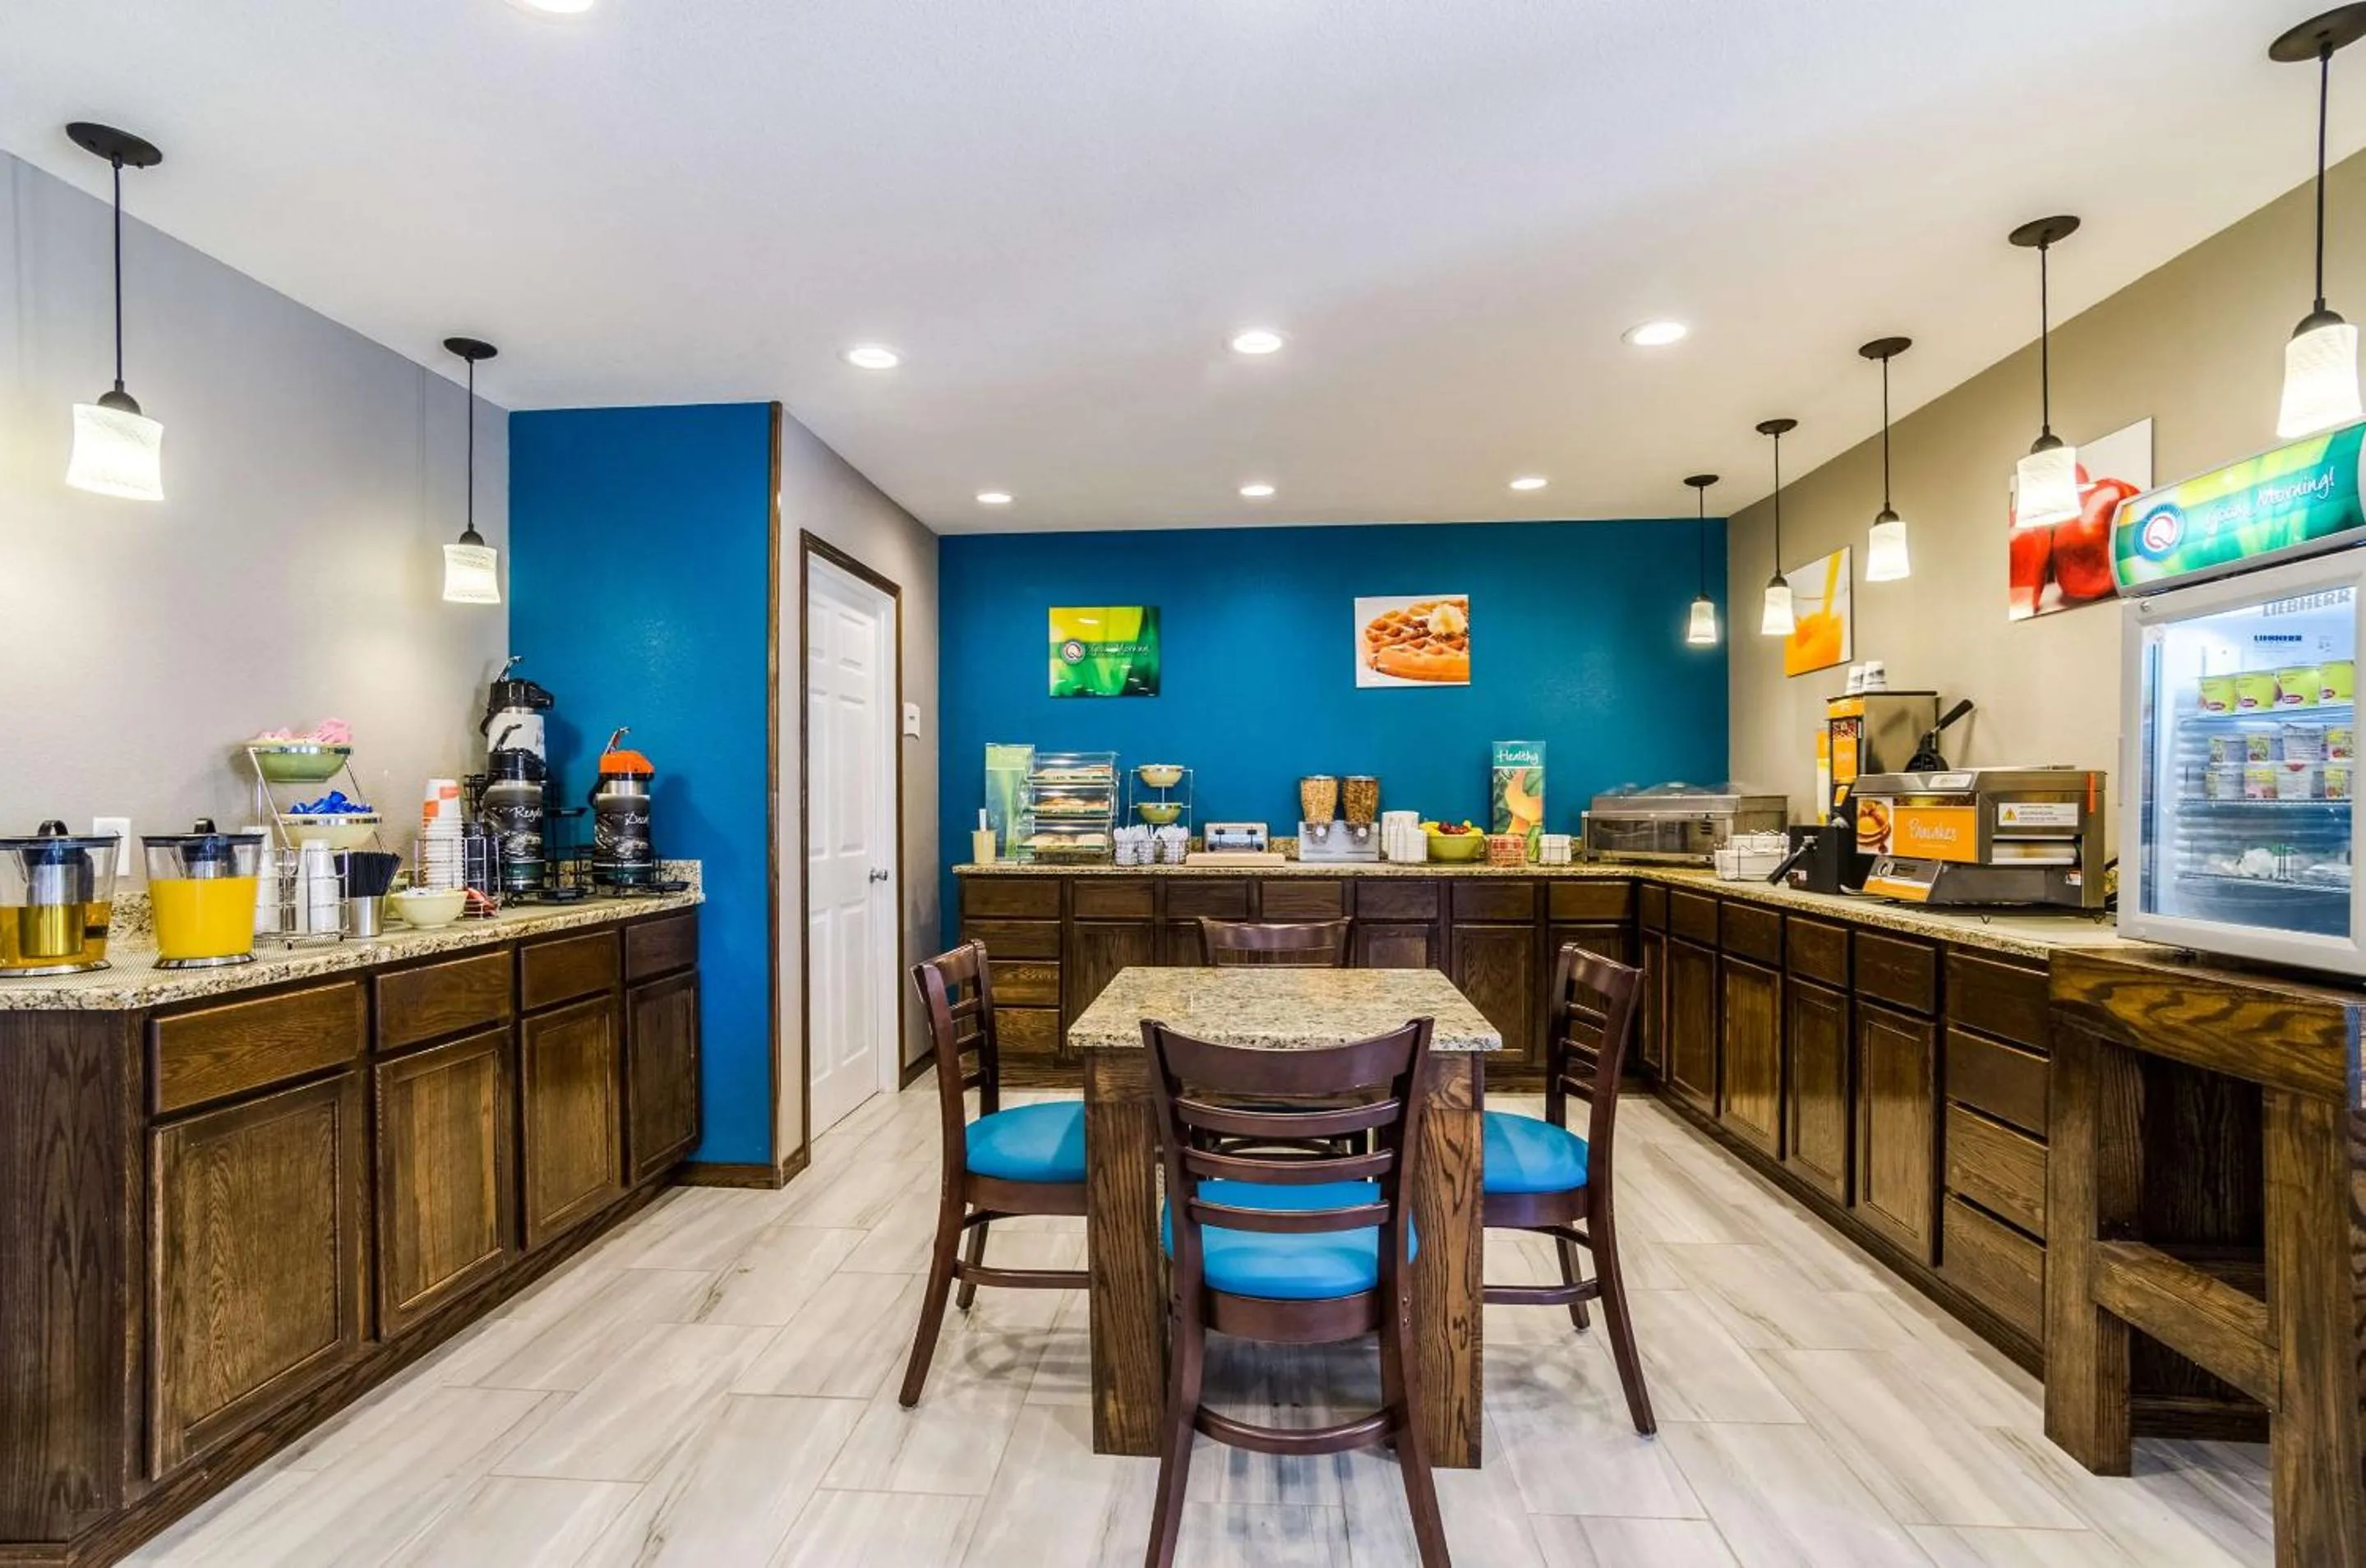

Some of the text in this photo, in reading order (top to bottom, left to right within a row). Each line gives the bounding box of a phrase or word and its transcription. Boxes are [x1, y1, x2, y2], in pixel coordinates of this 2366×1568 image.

[2257, 466, 2335, 506] Morning!
[2262, 590, 2350, 617] LIEBHERR
[1496, 749, 1538, 766] Healthy
